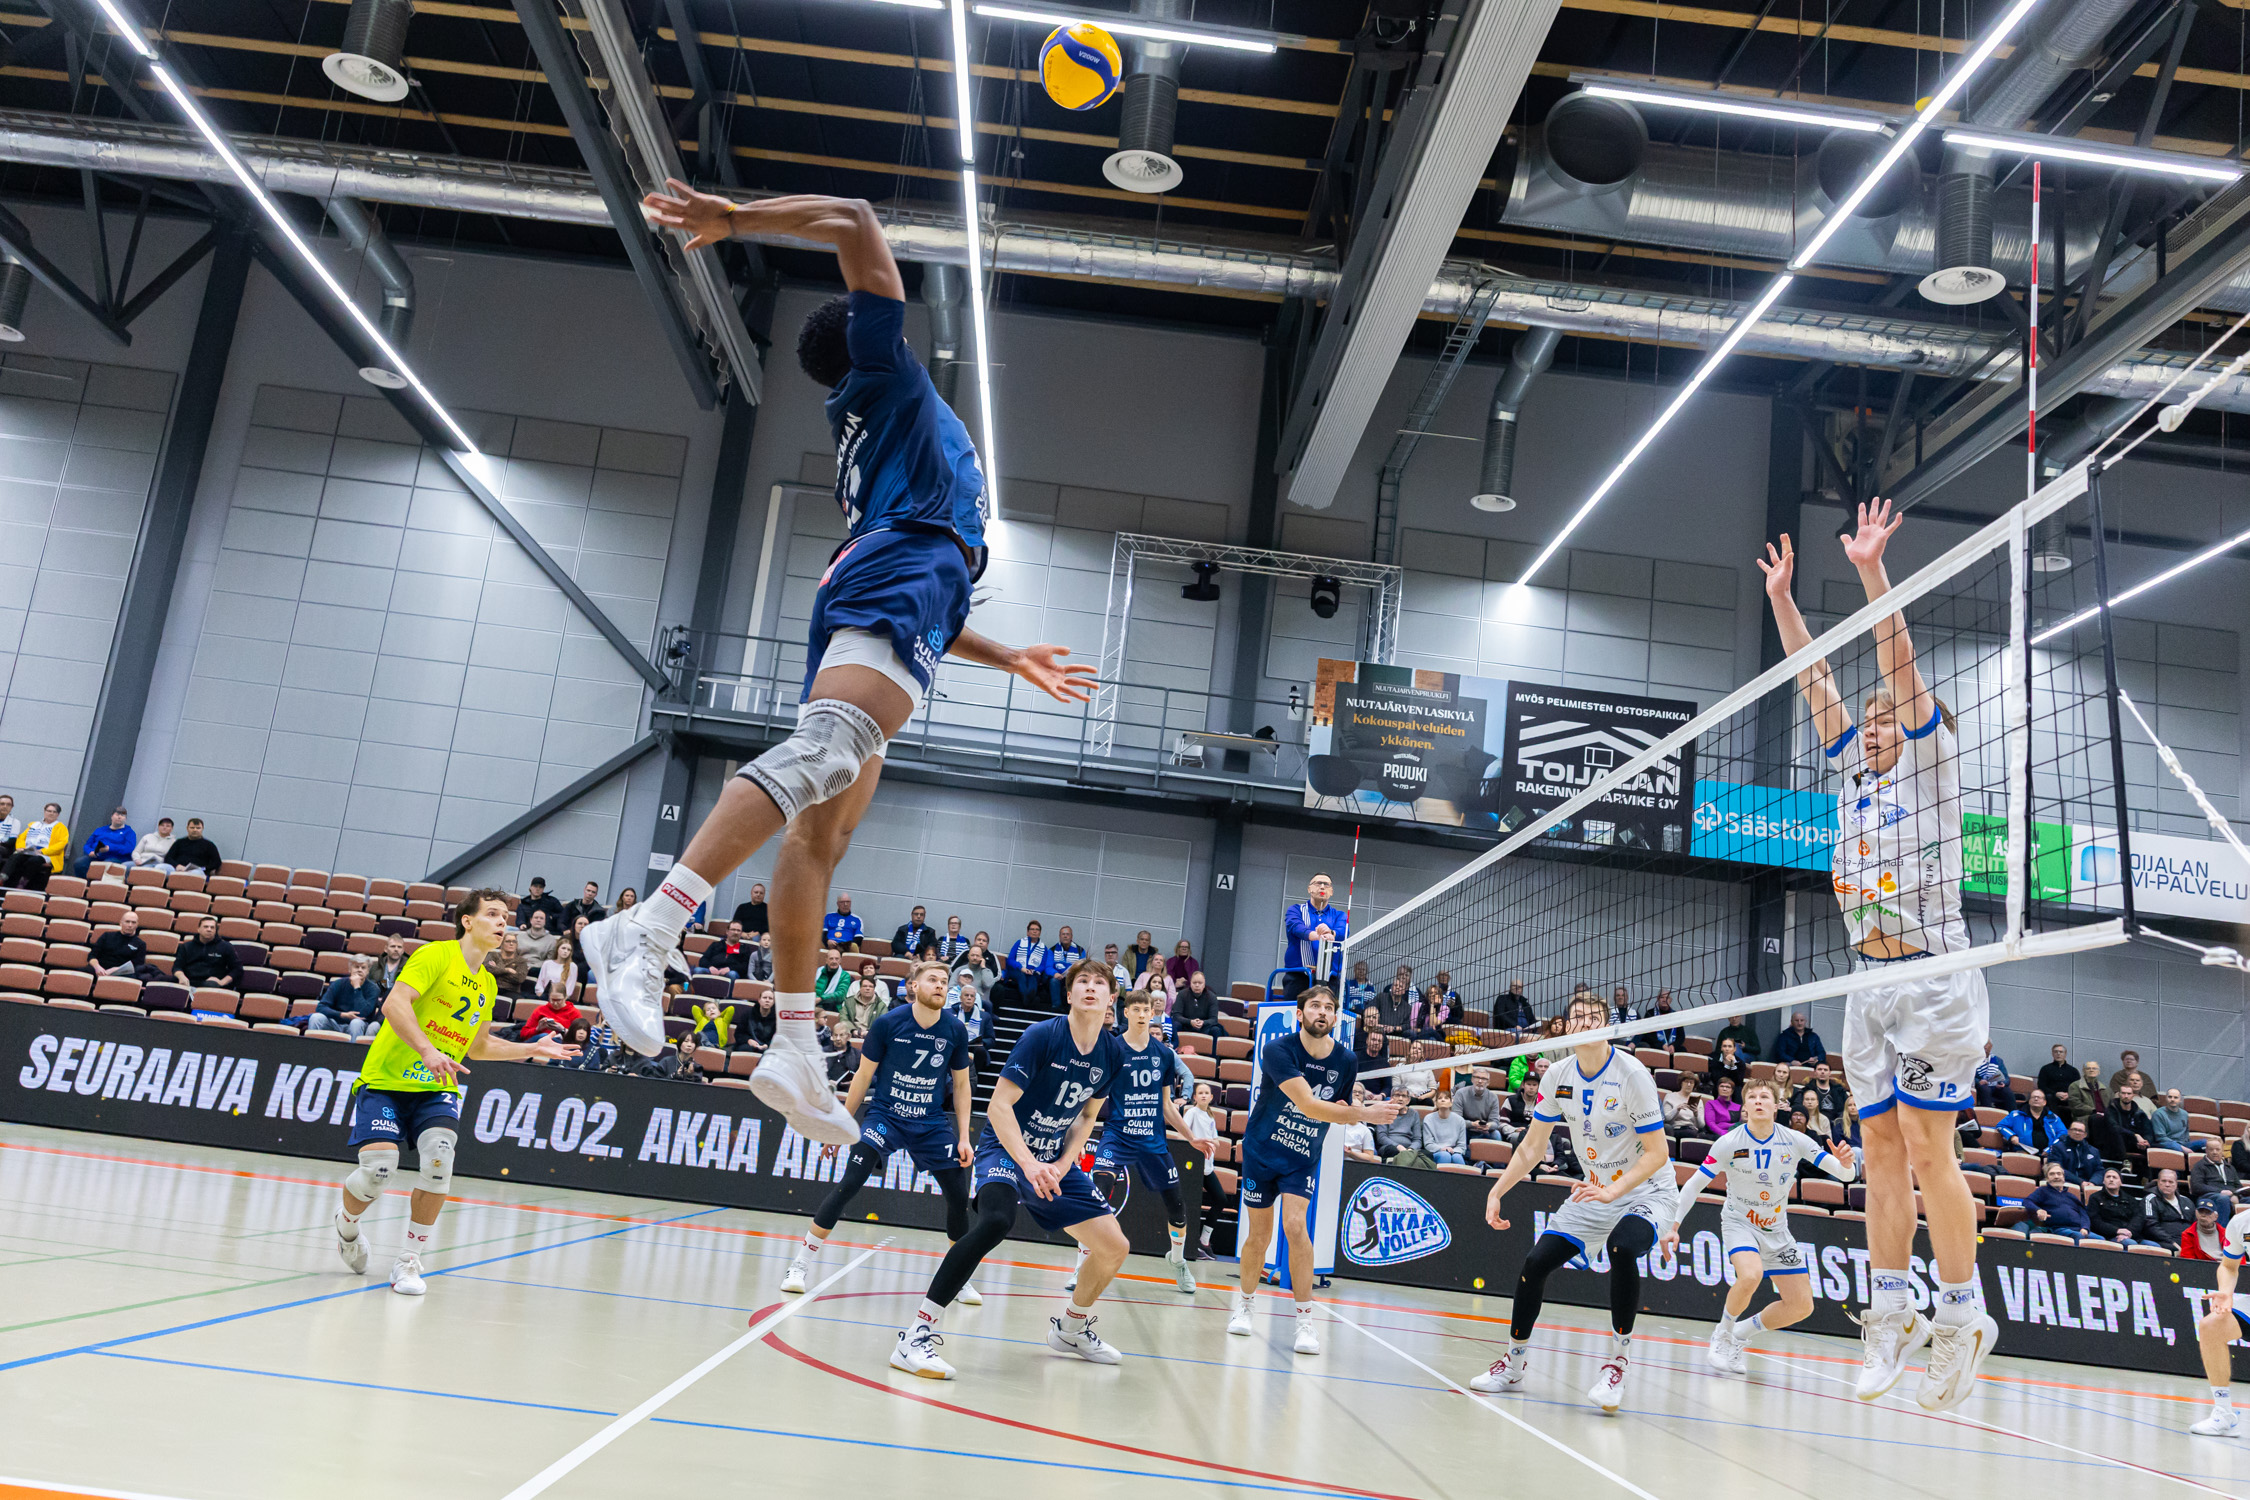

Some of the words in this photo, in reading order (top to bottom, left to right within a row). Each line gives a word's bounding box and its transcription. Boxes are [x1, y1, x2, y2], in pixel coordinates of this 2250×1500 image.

[1078, 50, 1100, 64] V200W
[1346, 698, 1423, 716] NUUTAJÄRVEN
[1424, 707, 1475, 722] LASIKYLÄ
[1515, 693, 1544, 704] MYÖS
[1547, 697, 1613, 713] PELIMIESTEN
[1615, 705, 1690, 722] OSTOSPAIKKA!
[1353, 713, 1466, 737] Kokouspalveluiden
[1380, 734, 1435, 750] ykkönen.
[1382, 763, 1428, 782] PRUUKI
[663, 805, 675, 820] A
[1658, 798, 1679, 810] OY
[2117, 851, 2209, 879] OIJALAN
[1218, 875, 1230, 889] A
[2121, 870, 2248, 901] VI-PALVELU
[1765, 939, 1777, 953] A
[451, 996, 471, 1022] 2
[911, 1049, 929, 1069] 7
[1130, 1069, 1152, 1088] 10
[441, 1092, 453, 1104] 2
[890, 1086, 933, 1104] KALEVA
[1054, 1080, 1083, 1109] 13
[1939, 1082, 1957, 1099] 12
[19, 1034, 259, 1115] SEURAAVA
[473, 1084, 624, 1158] 04.02.
[638, 1107, 762, 1174] AKAA
[1582, 1089, 1594, 1116] 5
[1124, 1108, 1157, 1117] KALEVA
[1122, 1126, 1154, 1136] ENERGIA
[1128, 1119, 1154, 1128] OULUN
[1276, 1114, 1319, 1138] KALEVA
[1270, 1133, 1311, 1158] ENERGIA
[1277, 1128, 1310, 1147] OULUN
[944, 1144, 953, 1158] 7
[1754, 1149, 1772, 1169] 17
[1167, 1166, 1178, 1180] 10
[1380, 1213, 1435, 1235] AKAA
[1380, 1225, 1438, 1260] VOLLEY
[1997, 1265, 2177, 1346] VALEPA,
